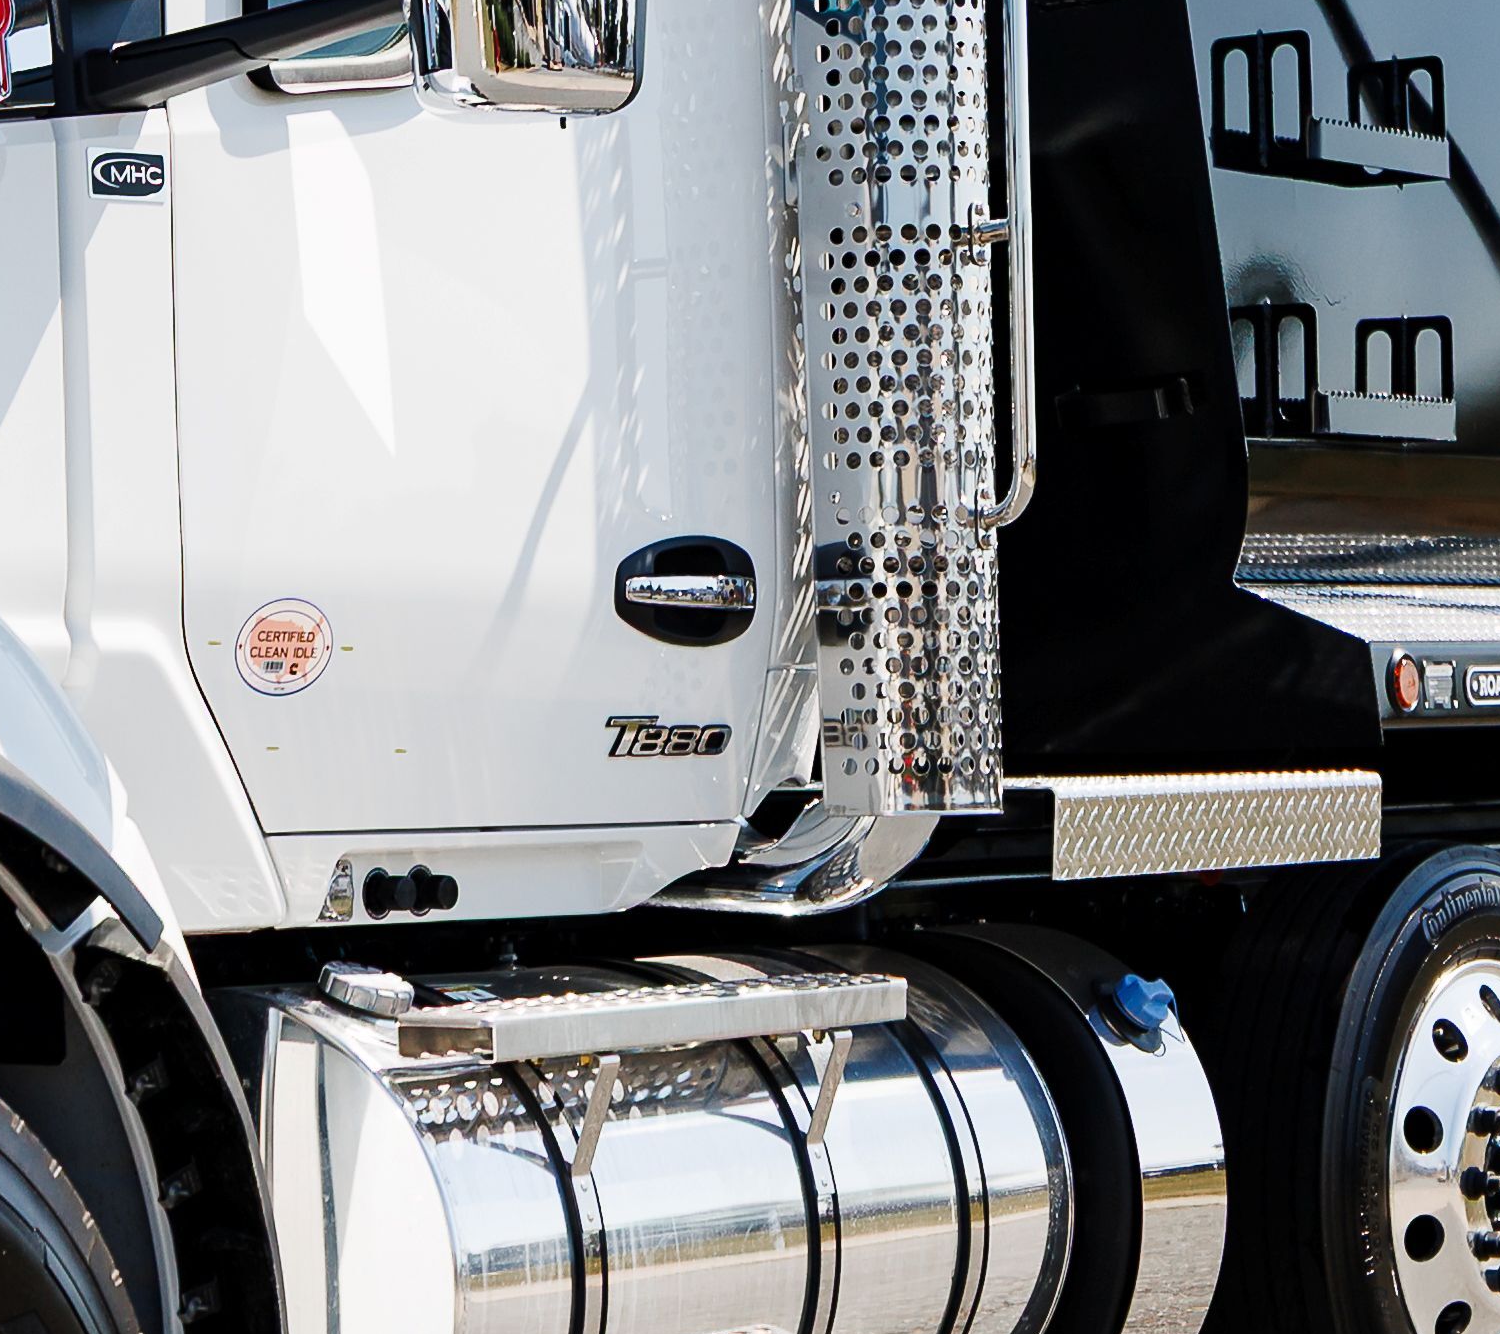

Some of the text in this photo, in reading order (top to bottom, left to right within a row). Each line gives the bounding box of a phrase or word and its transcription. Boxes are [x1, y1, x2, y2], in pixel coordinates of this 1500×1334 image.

[110, 164, 163, 185] MHC
[257, 630, 316, 643] CERTIFIED
[249, 646, 318, 659] CLEAN IDLE
[604, 715, 733, 758] T880
[1421, 876, 1500, 950] Continental
